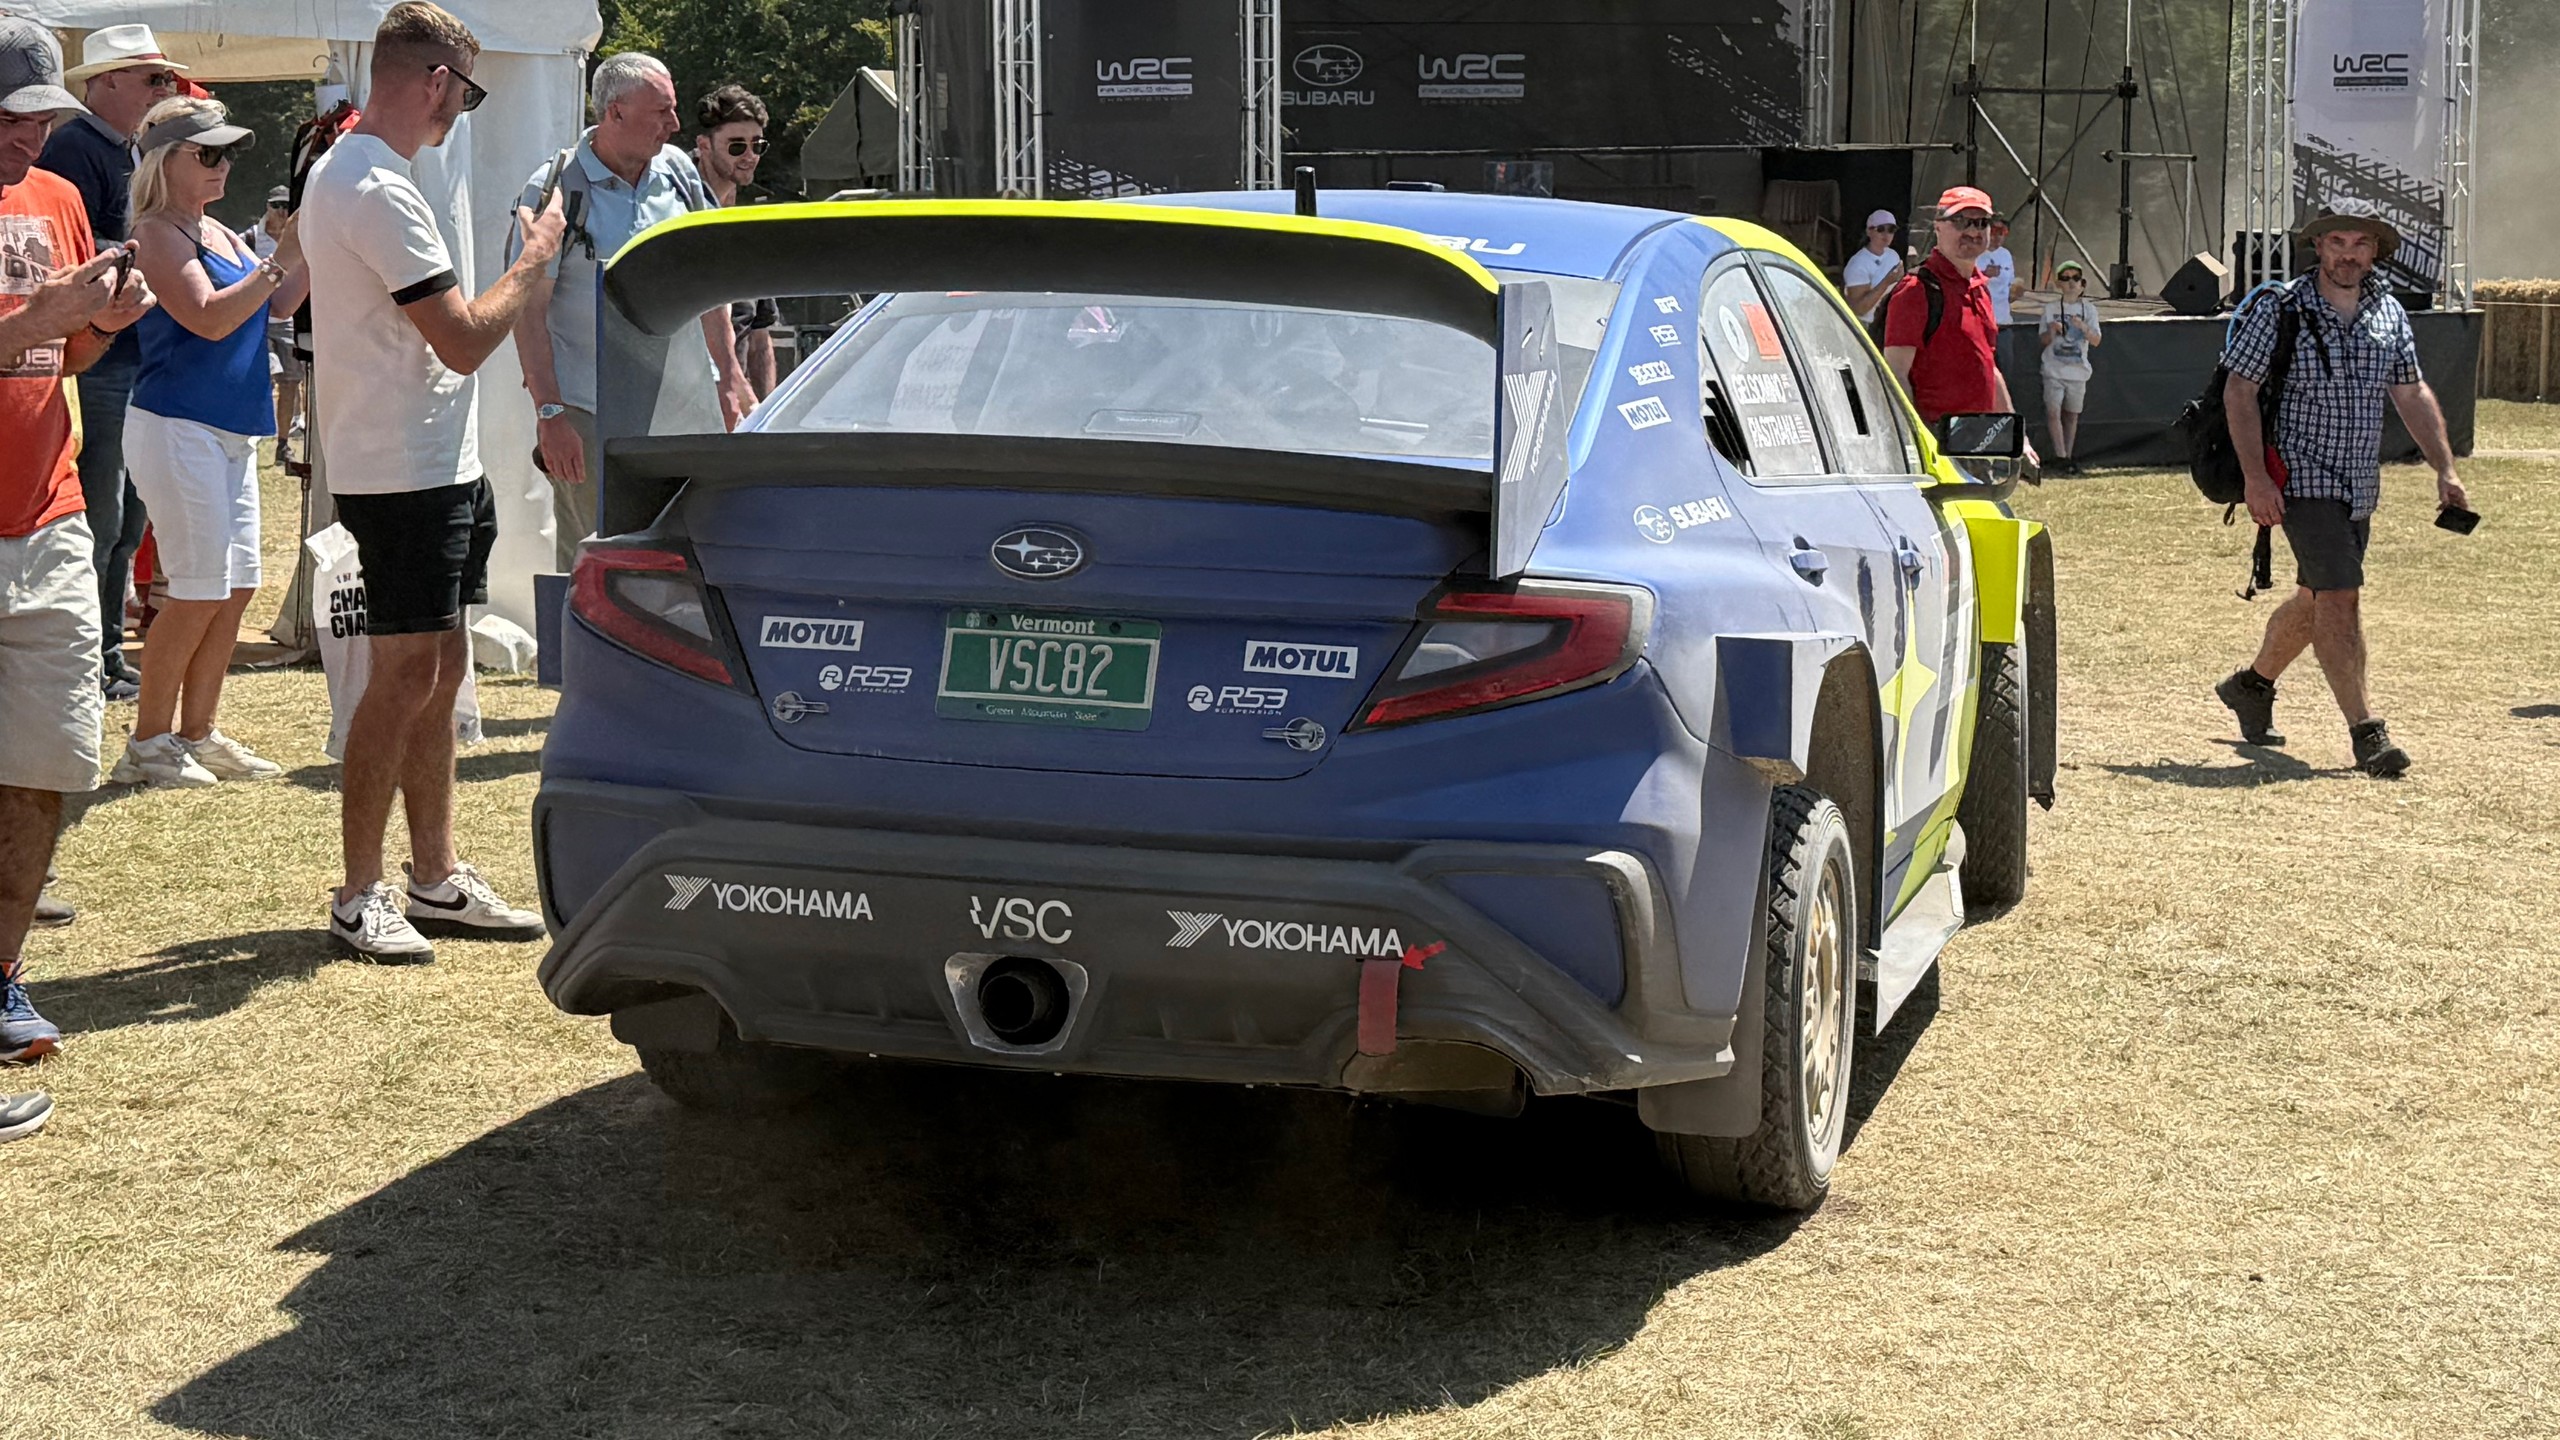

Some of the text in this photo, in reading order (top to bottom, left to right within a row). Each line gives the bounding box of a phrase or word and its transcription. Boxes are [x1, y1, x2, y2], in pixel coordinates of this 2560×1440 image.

[1097, 57, 1192, 81] WRC
[1418, 54, 1526, 79] WRC
[2333, 54, 2408, 73] WRC
[1280, 90, 1375, 106] SUBARU
[765, 621, 857, 646] MOTUL
[1010, 614, 1096, 635] Vermont
[989, 637, 1114, 696] VSC82
[1249, 646, 1351, 674] MOTUL
[845, 665, 913, 688] R53
[1216, 686, 1289, 709] R53
[1214, 707, 1283, 717] SUSPENSION
[711, 882, 874, 921] YOKOHAMA
[969, 895, 1073, 945] VSC
[1222, 918, 1405, 958] YOKOHAMA
